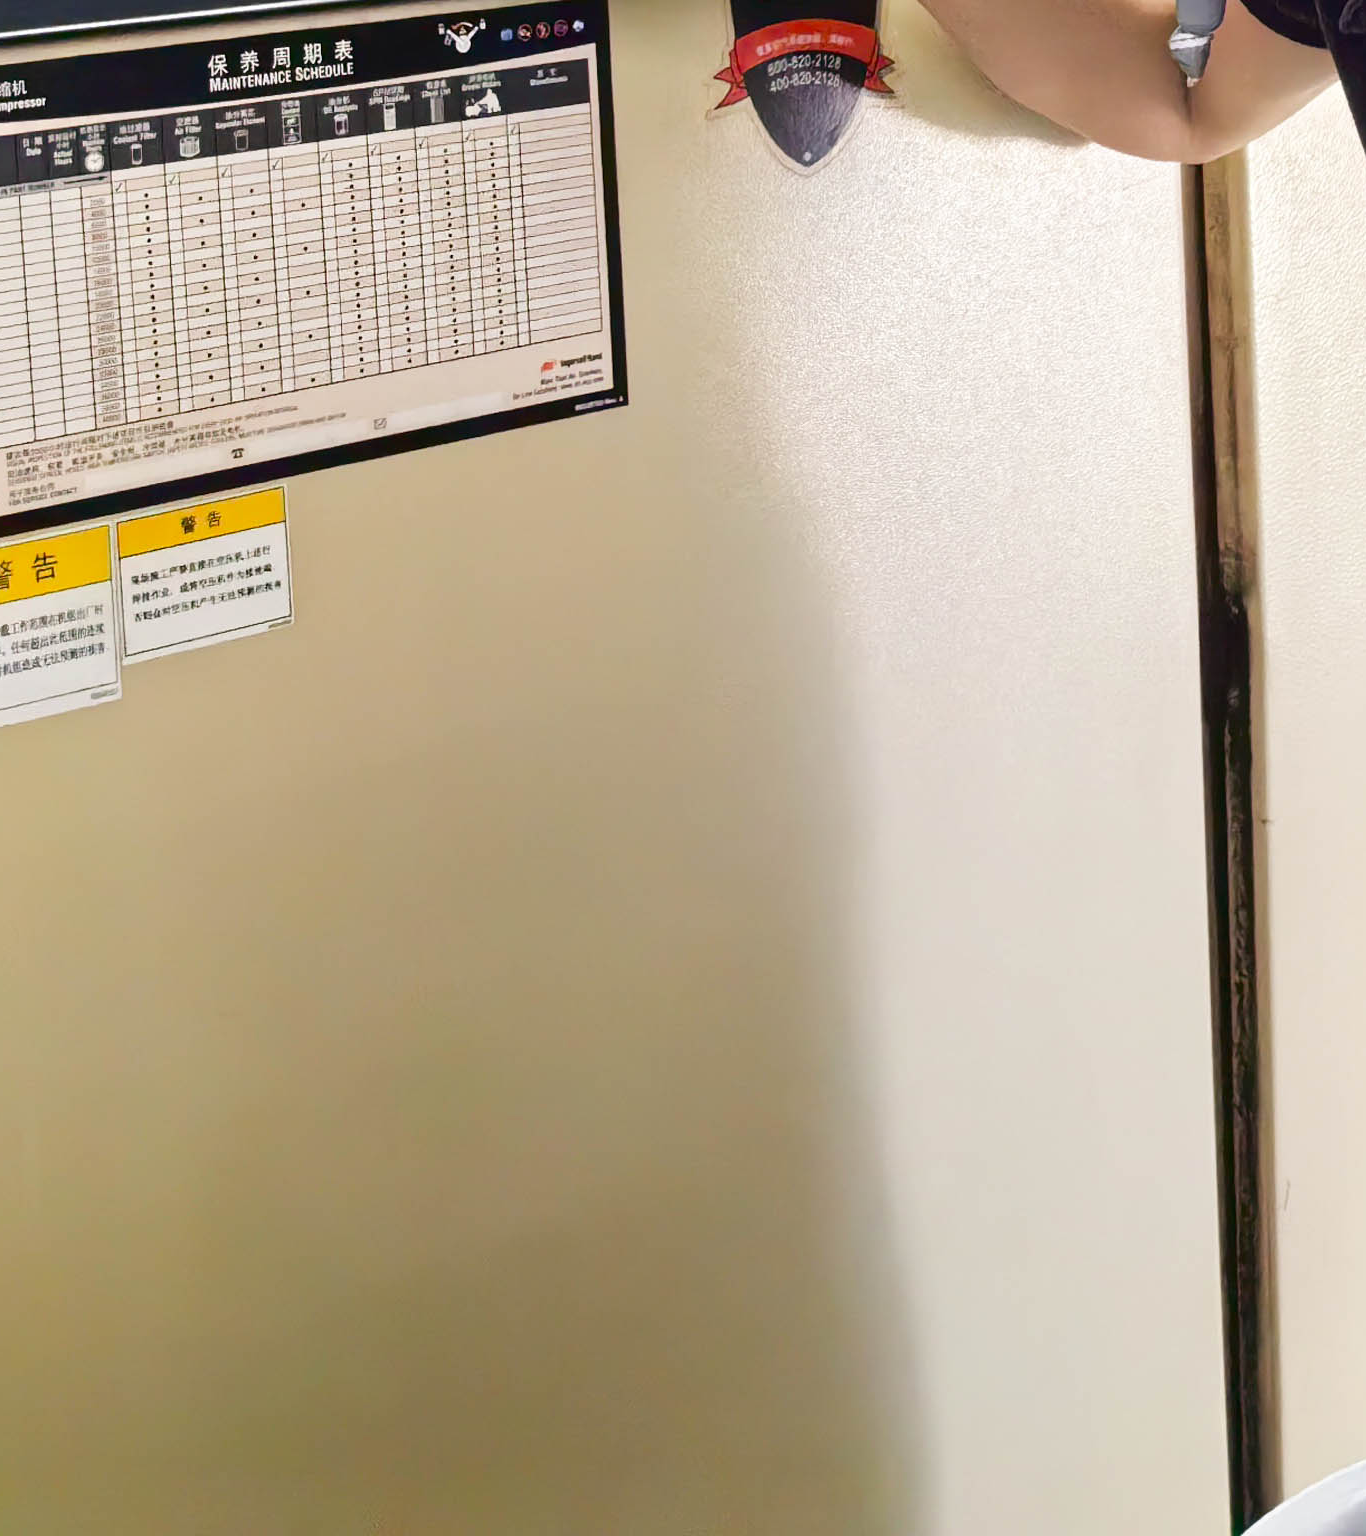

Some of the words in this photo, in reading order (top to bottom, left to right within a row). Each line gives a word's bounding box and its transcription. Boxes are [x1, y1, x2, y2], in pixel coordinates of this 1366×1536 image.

[209, 39, 354, 78] 保养周期表
[209, 70, 292, 93] MAINTENANCE
[295, 62, 354, 82] SCHEDULE
[181, 510, 221, 534] 警告
